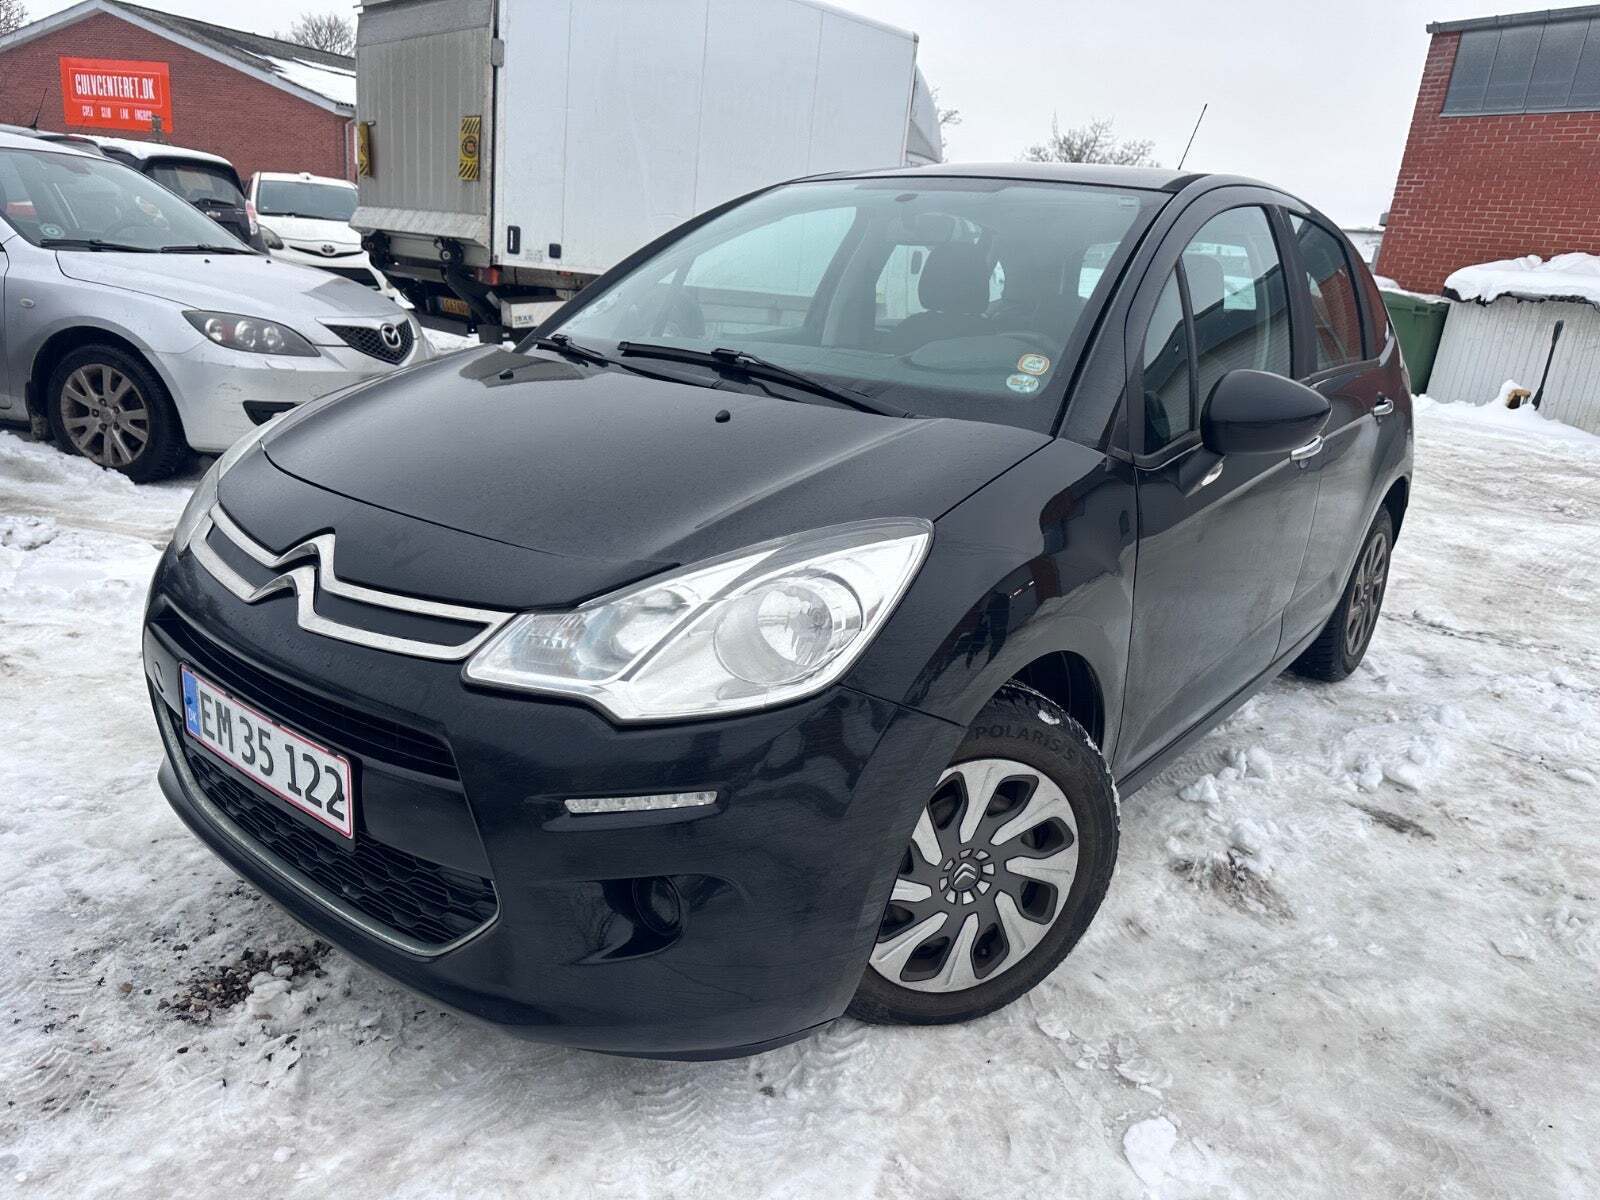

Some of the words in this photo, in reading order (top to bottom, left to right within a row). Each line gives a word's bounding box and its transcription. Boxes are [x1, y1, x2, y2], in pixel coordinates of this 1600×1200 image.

[74, 73, 155, 99] GULVCENTERET.DK
[974, 725, 1062, 752] POLARIS
[199, 690, 234, 753] EM
[239, 715, 275, 777] 35
[284, 743, 346, 822] 122
